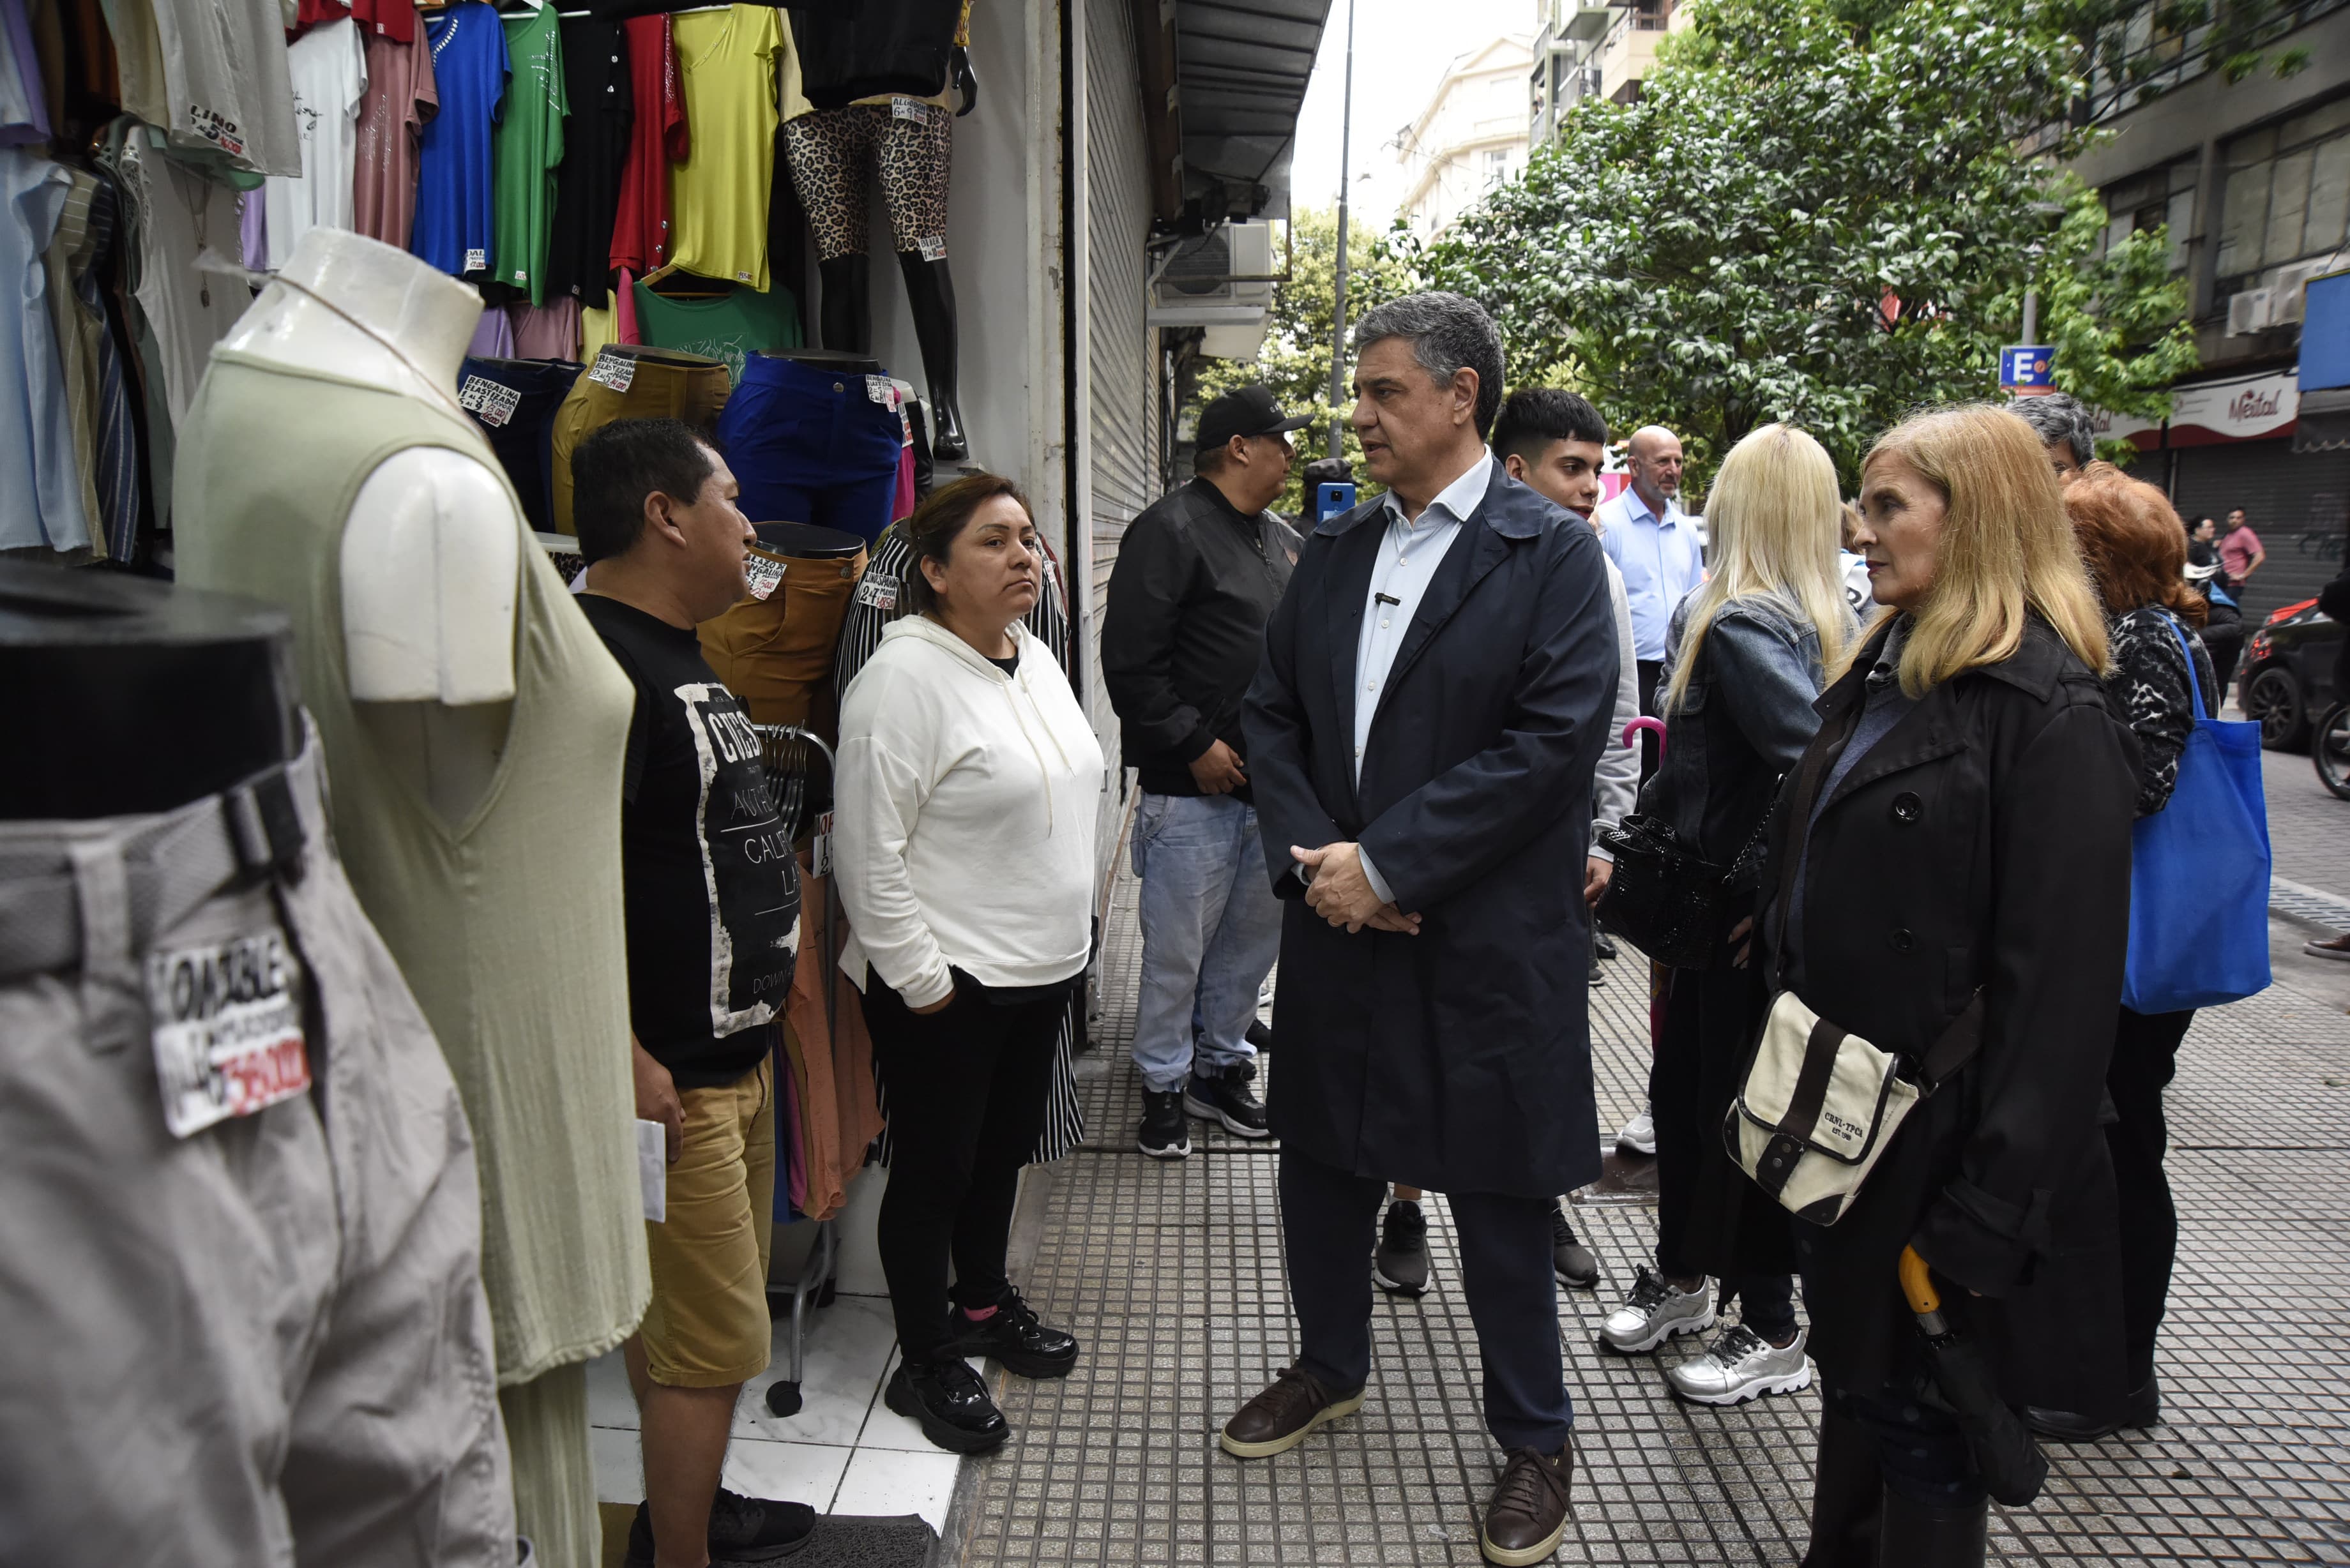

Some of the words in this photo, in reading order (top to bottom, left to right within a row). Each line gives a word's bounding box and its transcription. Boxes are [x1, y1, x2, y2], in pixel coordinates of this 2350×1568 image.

[893, 98, 926, 112] ALGODON
[894, 107, 900, 117] 6
[907, 107, 913, 119] 9
[191, 105, 236, 133] LINO
[205, 123, 219, 140] 5
[589, 369, 600, 379] 2
[603, 372, 613, 383] 5
[2013, 352, 2035, 382] E
[464, 384, 516, 407] ELASTIZADA
[467, 376, 519, 401] BENGALINA
[476, 395, 487, 403] 5
[751, 555, 776, 569] LAZO
[751, 563, 784, 577] NGALINA
[860, 585, 869, 602] 2
[872, 587, 879, 604] 7
[708, 711, 763, 764] GUES
[745, 828, 792, 864] CALIF
[782, 861, 801, 895] LA
[754, 969, 785, 994] DOWN
